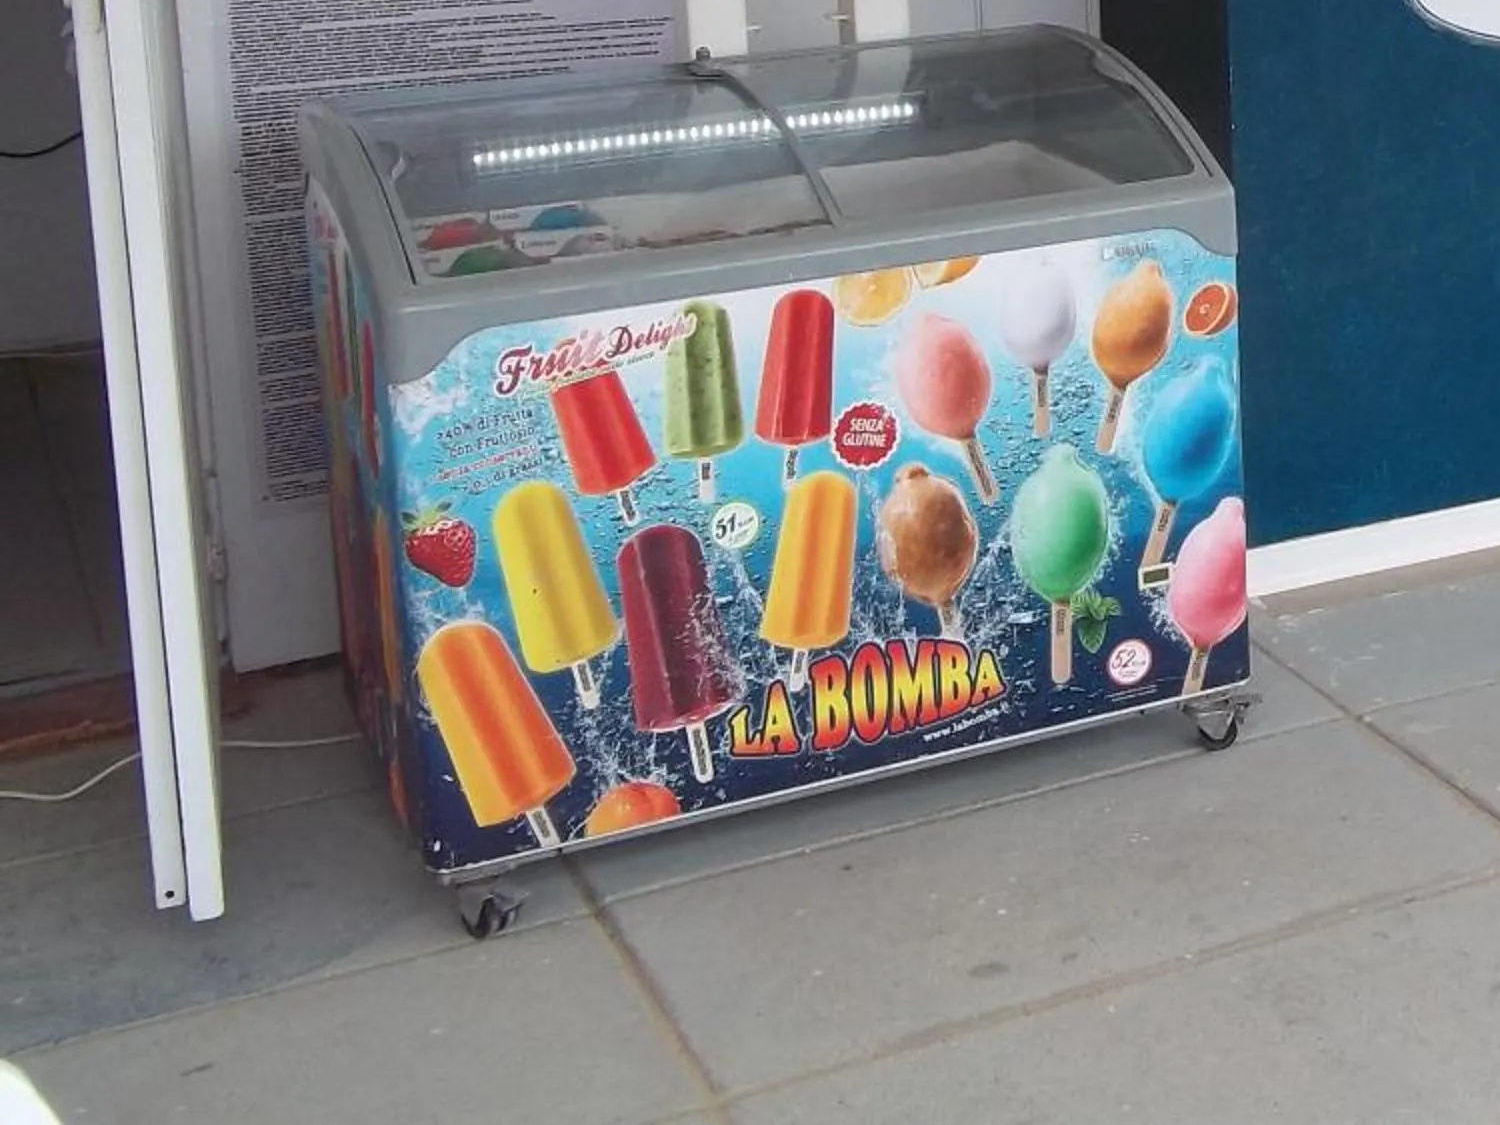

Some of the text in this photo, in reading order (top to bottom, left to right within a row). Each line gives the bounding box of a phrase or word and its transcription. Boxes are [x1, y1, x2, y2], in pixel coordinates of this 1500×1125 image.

[496, 329, 604, 395] Fruit
[605, 312, 698, 358] Delight
[842, 432, 887, 447] GLUTINE
[850, 418, 885, 432] SENZA
[729, 638, 1007, 758] LA BOMBA
